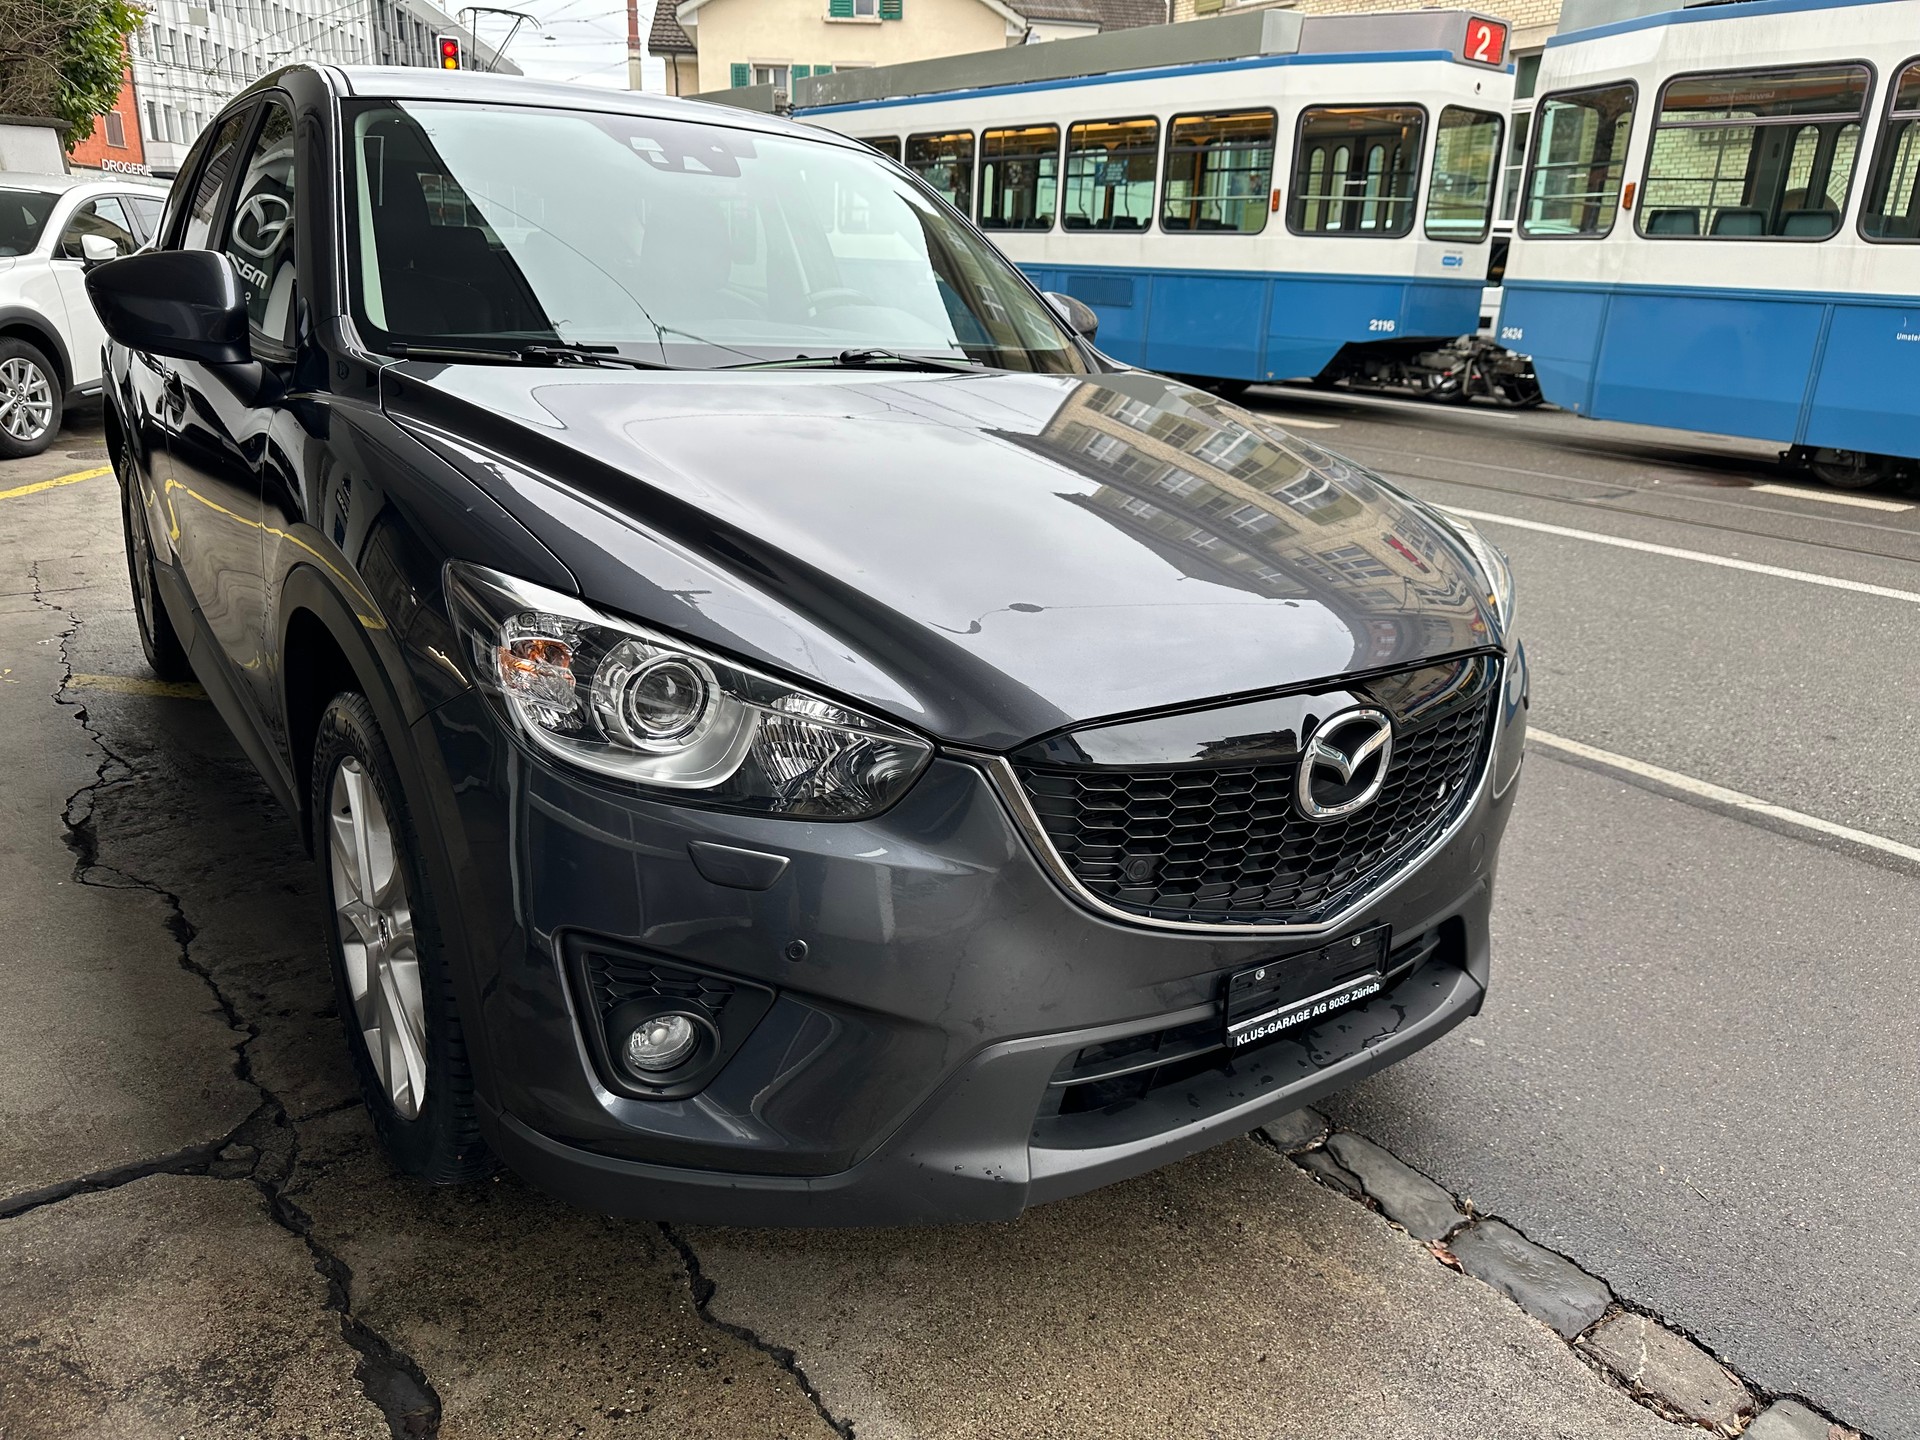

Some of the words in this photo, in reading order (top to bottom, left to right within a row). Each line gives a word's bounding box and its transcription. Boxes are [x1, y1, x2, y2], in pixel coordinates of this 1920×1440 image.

[1473, 26, 1491, 61] 2
[101, 158, 153, 177] DROGERIE
[1368, 318, 1395, 332] 2116
[1501, 326, 1523, 340] 2424
[1236, 1009, 1310, 1046] KLUS-GARAGE
[1312, 1002, 1327, 1017] AG
[1328, 994, 1350, 1010] 8032
[1351, 982, 1380, 1001] Zürich
